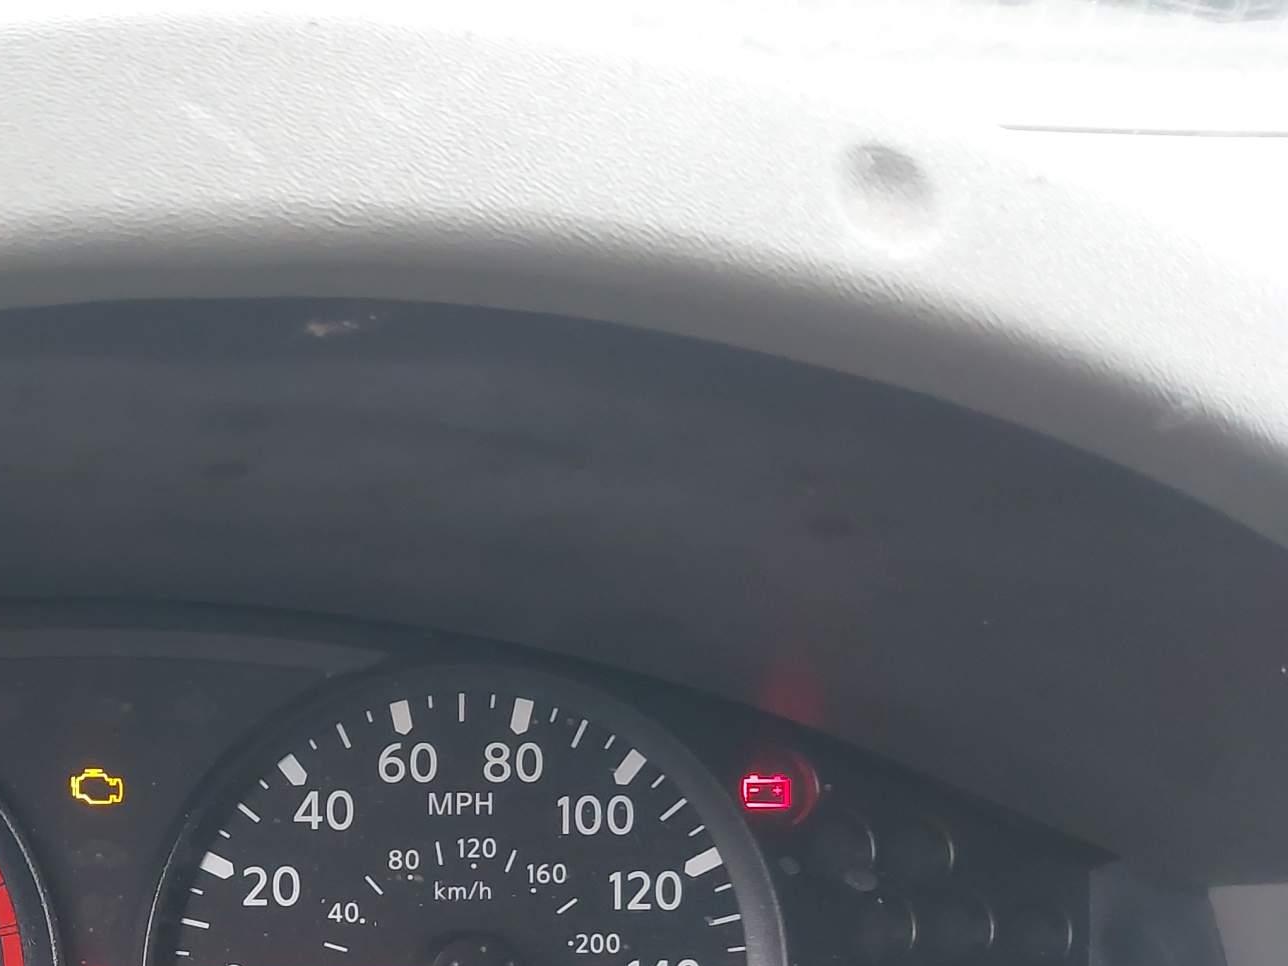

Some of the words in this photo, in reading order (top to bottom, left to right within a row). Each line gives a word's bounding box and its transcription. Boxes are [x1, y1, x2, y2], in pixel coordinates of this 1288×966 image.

[378, 742, 438, 783] 60
[483, 742, 543, 783] 80
[293, 790, 354, 831] 40
[428, 792, 493, 816] MPH
[557, 795, 634, 835] 100
[388, 849, 420, 870] 80
[457, 838, 497, 858] 120
[527, 863, 567, 884] 160
[242, 866, 300, 907] 20
[434, 881, 492, 901] km/h
[608, 870, 683, 911] 120
[327, 902, 359, 923] 40
[575, 933, 620, 954] 200
